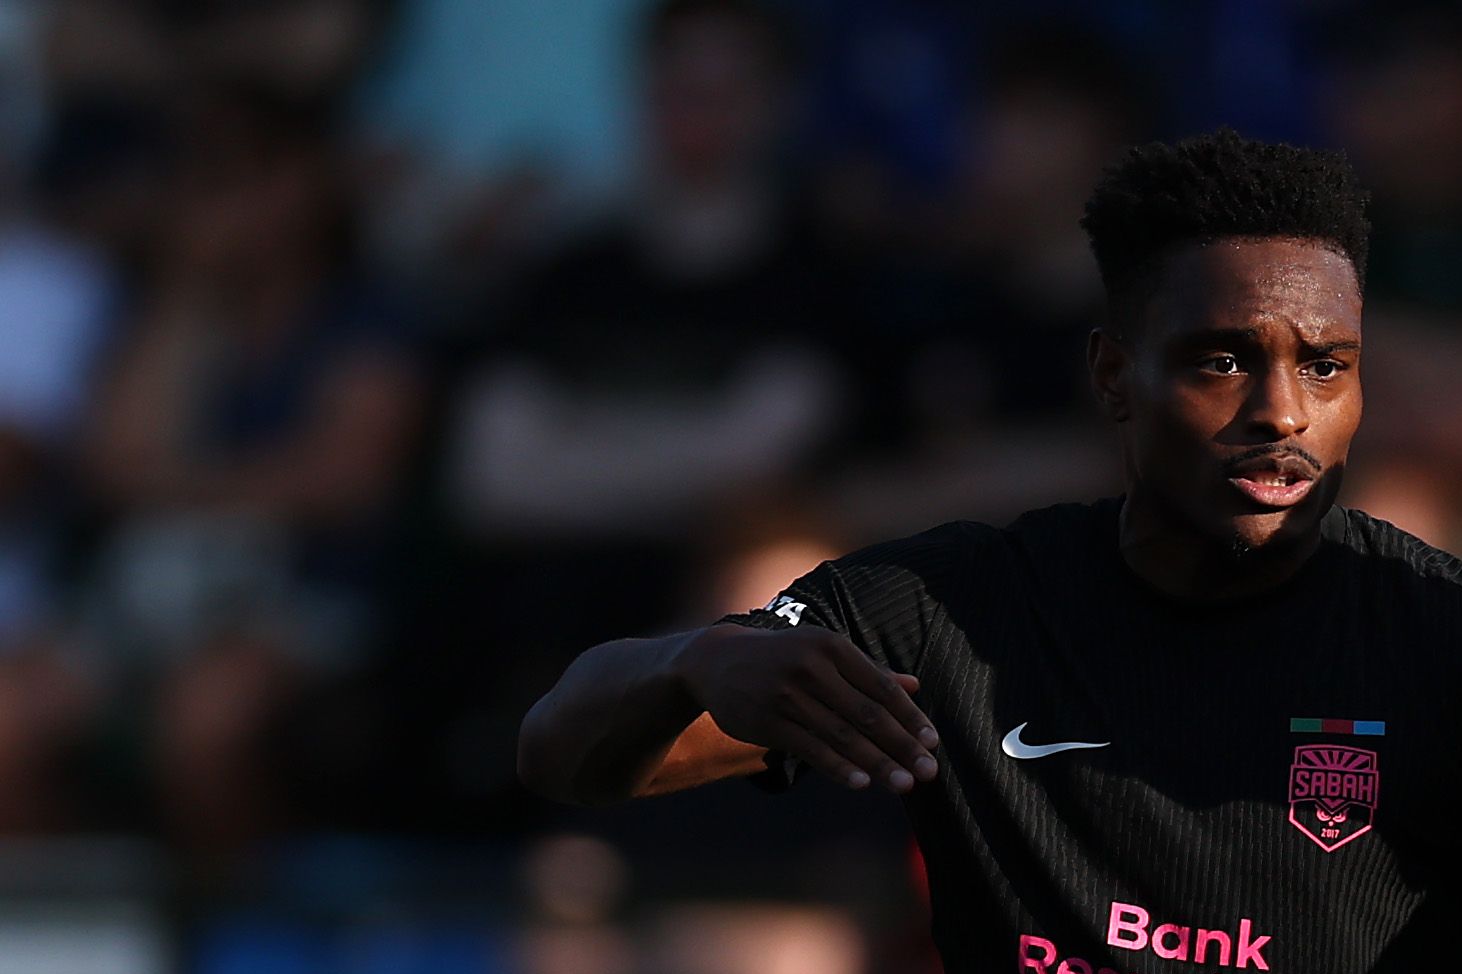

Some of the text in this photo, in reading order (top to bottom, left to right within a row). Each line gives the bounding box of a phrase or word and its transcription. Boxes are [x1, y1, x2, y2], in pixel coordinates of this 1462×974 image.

[1294, 770, 1373, 803] SABAH
[1321, 827, 1340, 839] 2017
[1106, 901, 1272, 973] Bank
